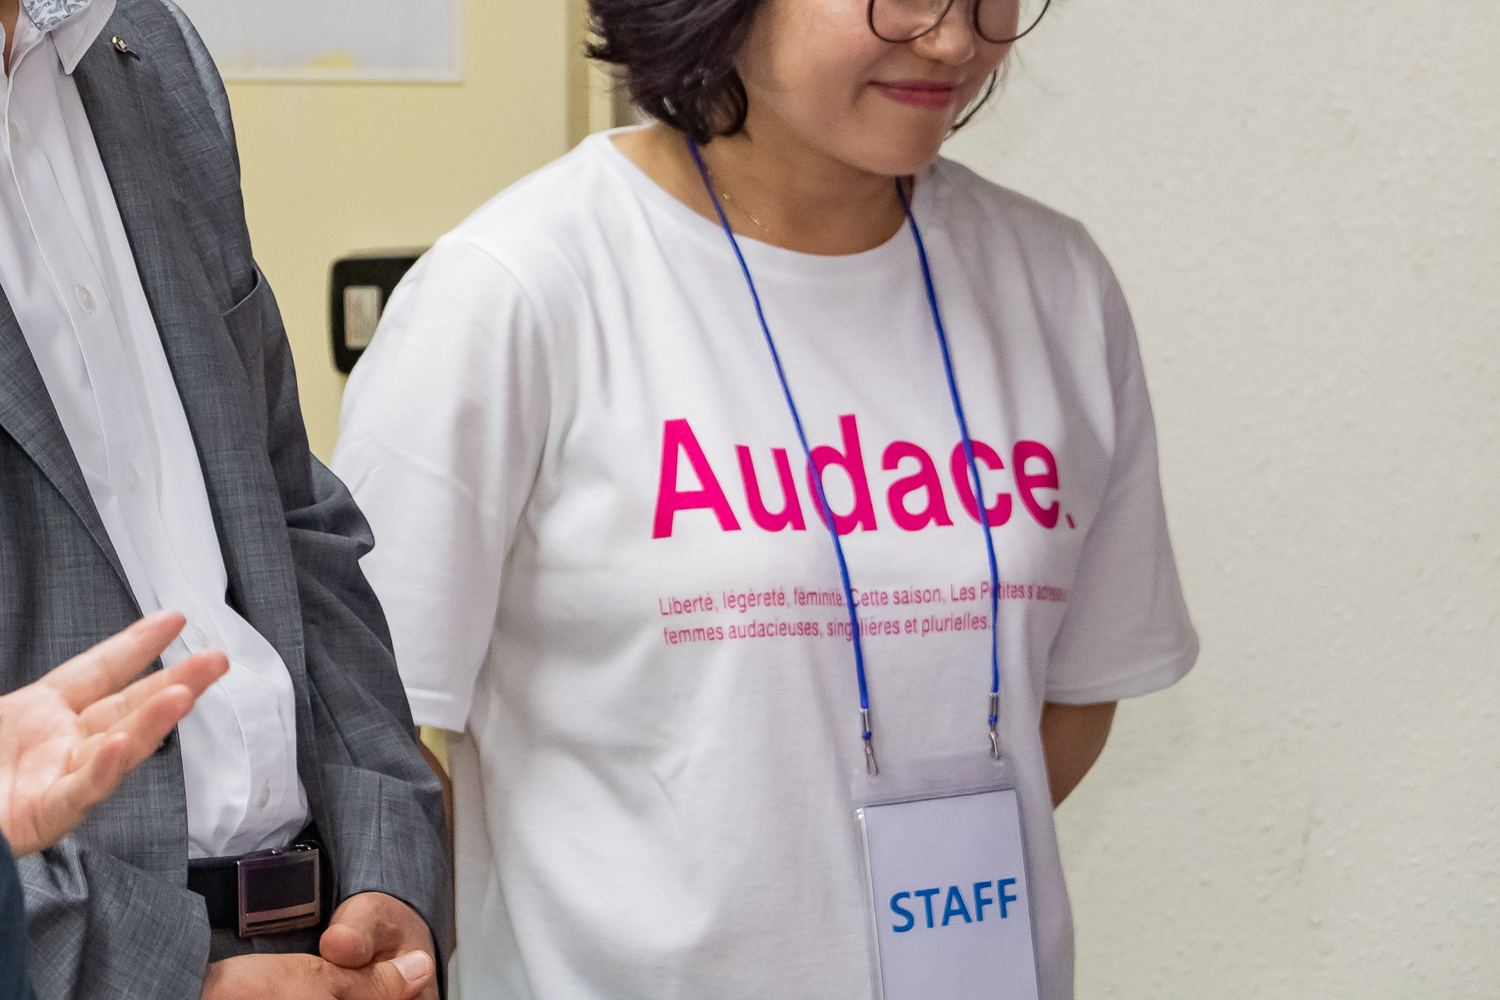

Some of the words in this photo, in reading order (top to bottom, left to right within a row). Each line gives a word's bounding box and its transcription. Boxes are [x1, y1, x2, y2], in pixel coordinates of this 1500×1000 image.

[651, 413, 1076, 539] Audace.
[658, 592, 719, 616] Liberté,
[722, 586, 790, 613] légèreté,
[849, 587, 889, 608] Cette
[892, 585, 947, 606] saison,
[951, 583, 976, 602] Les
[663, 625, 724, 645] femmes
[728, 618, 823, 640] audacieuses,
[826, 616, 901, 642] singlières
[904, 617, 918, 635] et
[921, 612, 991, 637] plurielles.
[889, 877, 1017, 933] STAFF
